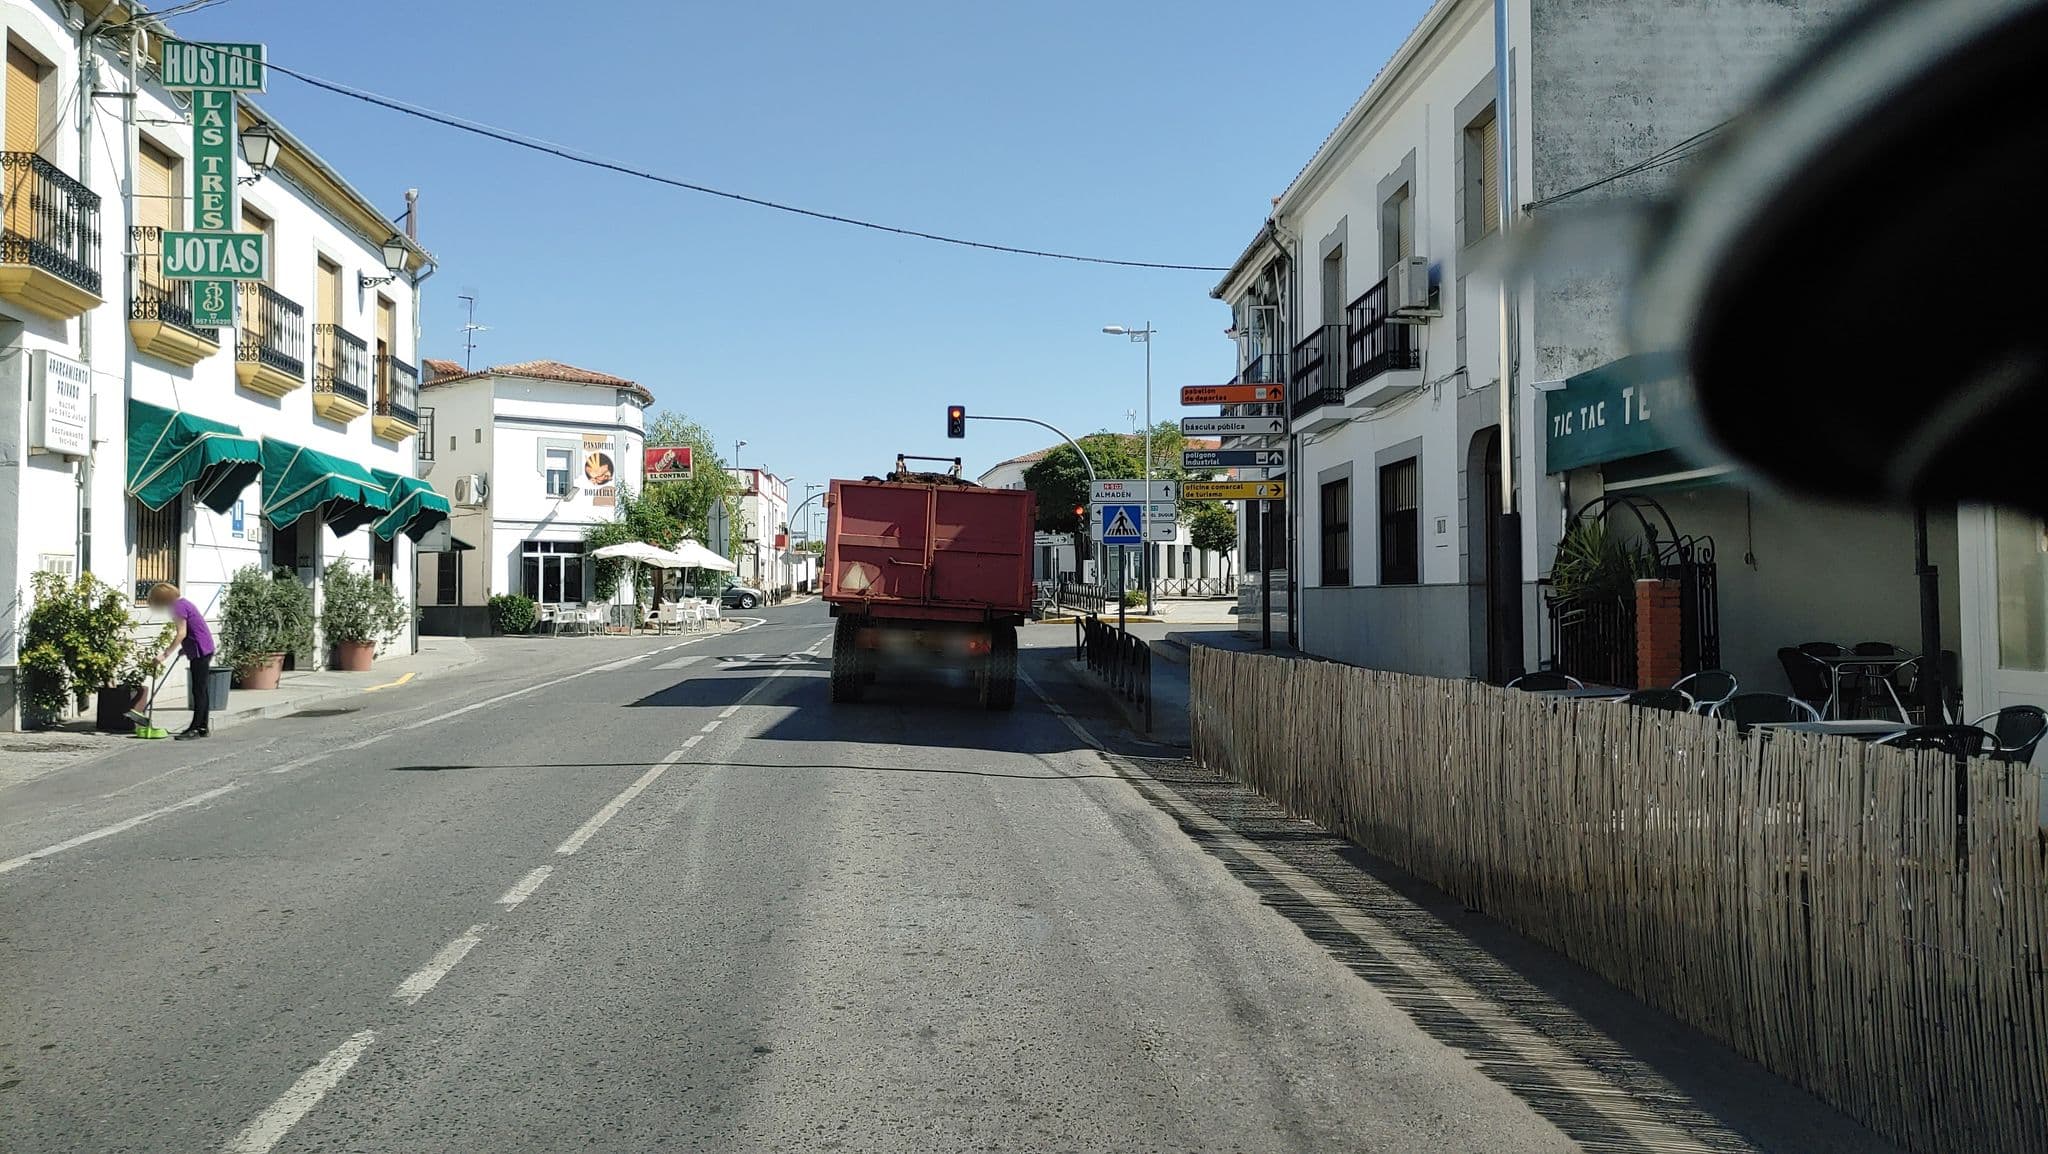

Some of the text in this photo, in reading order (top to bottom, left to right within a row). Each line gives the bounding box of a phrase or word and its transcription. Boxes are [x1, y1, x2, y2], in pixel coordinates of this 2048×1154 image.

[165, 44, 259, 87] HOSTAL
[200, 91, 226, 230] LAS TRES
[166, 236, 260, 274] JOTAS
[49, 357, 88, 385] APARCAMIENTO
[57, 379, 80, 400] PRIVADO
[1185, 422, 1246, 432] báscula pública
[1554, 411, 1573, 438] TIC
[1580, 400, 1605, 431] TAC
